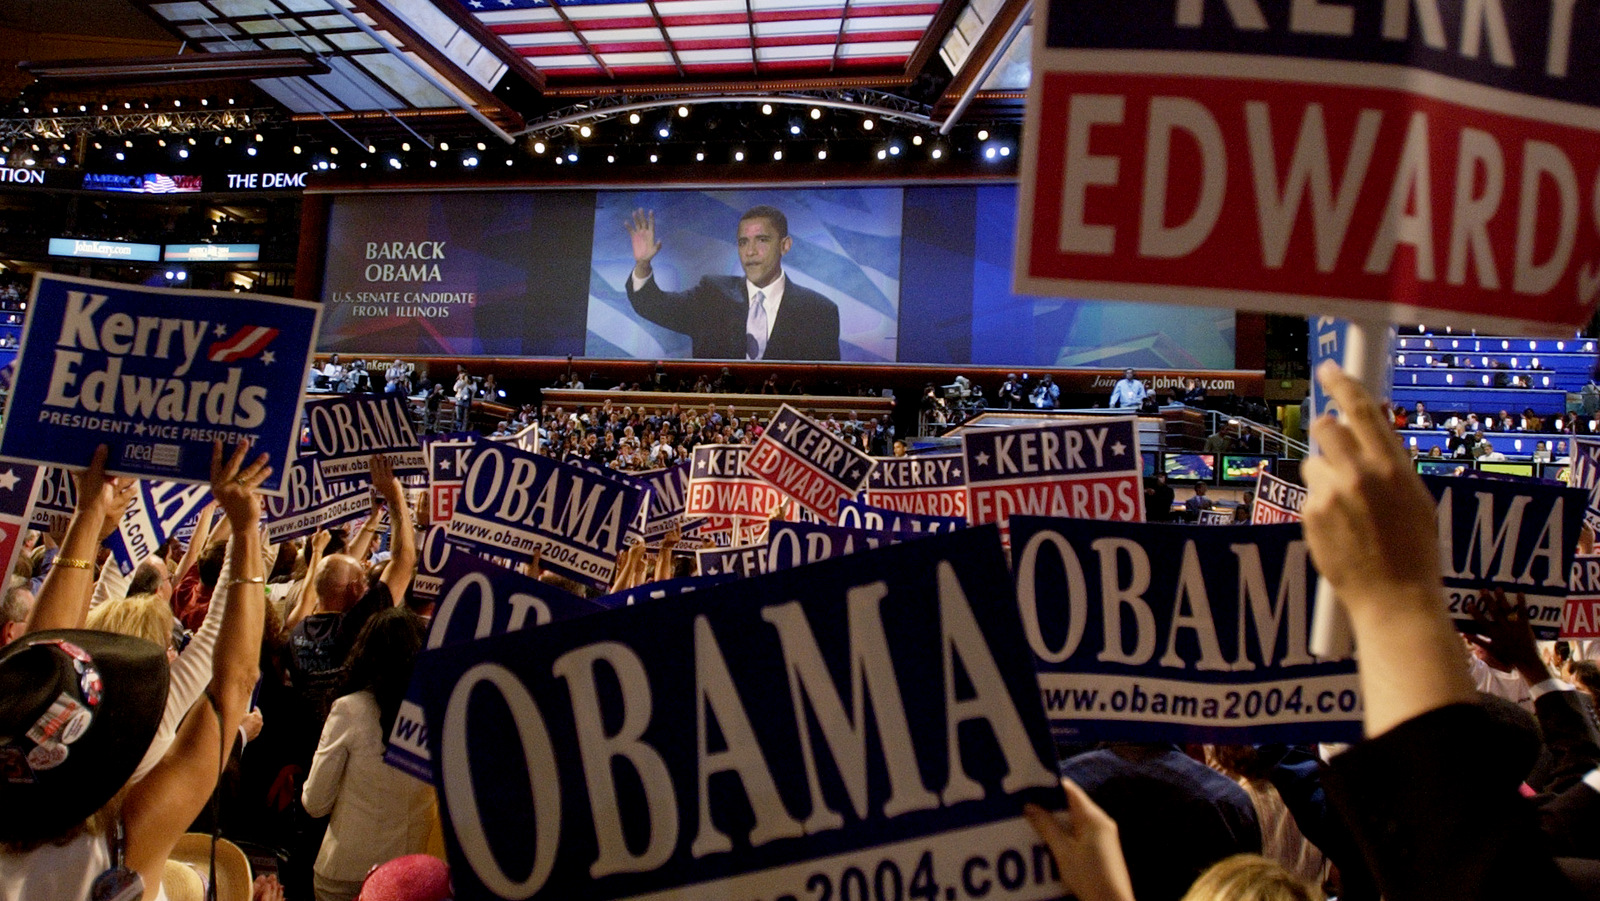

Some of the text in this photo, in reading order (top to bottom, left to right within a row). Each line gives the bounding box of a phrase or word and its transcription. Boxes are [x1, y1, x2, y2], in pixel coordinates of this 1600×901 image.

[227, 173, 258, 189] THE
[1059, 94, 1600, 305] EDWARD
[74, 240, 132, 256] JohnKerry.com
[366, 241, 446, 259] BARACK
[365, 264, 442, 282] OBAMA
[332, 292, 476, 304] U.S. SENATE CANDIDATE
[352, 306, 450, 318] FROM ILLINOIS
[56, 290, 209, 377] Kerry
[42, 349, 268, 429] Edwards
[38, 410, 260, 448] PRESIDENT VICE PRESIDENT
[311, 397, 420, 457] OBAMA
[783, 419, 859, 480] KERRY
[124, 443, 152, 461] nea
[883, 459, 952, 487] KERRY
[995, 426, 1110, 476] KERRY
[465, 447, 625, 557] OBAMA
[691, 484, 785, 514] EDWARD
[750, 441, 849, 521] EDWARDS
[976, 480, 1137, 526] EDWARDS
[269, 497, 371, 536] www.obama2004.com
[452, 519, 612, 580] www.obama2004.com
[1017, 529, 1358, 672] OBAM
[1044, 684, 1363, 719] ww.obama2004.co
[441, 560, 1059, 901] OBAMA
[777, 850, 1061, 901] 2004.com
